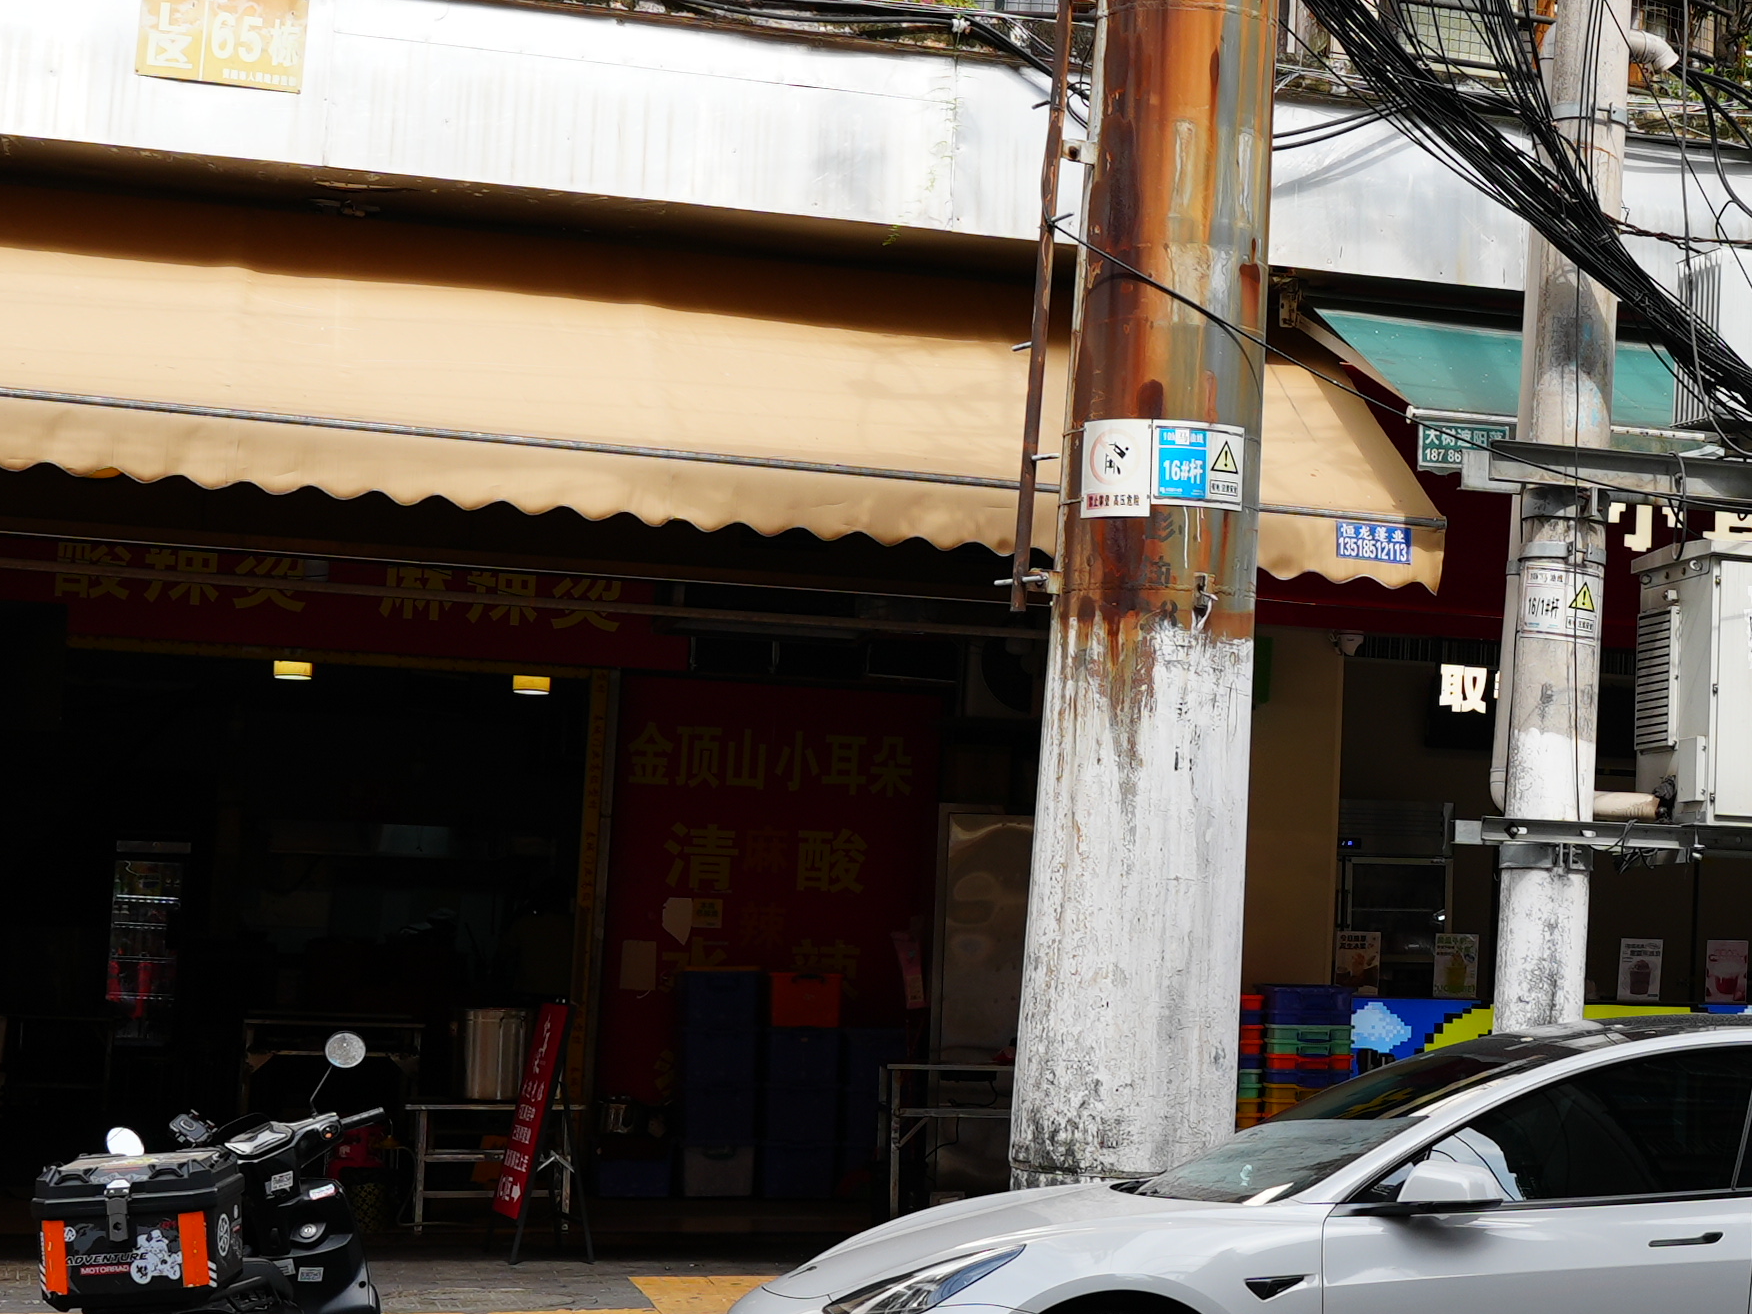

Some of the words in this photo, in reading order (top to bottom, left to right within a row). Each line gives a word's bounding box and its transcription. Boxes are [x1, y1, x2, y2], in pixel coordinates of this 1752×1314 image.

[1425, 448, 1444, 462] 187
[1163, 459, 1204, 485] 16#杆
[1338, 536, 1408, 562] 13518512113
[627, 720, 916, 798] 金顶山小耳朵
[65, 1251, 149, 1267] ADVENTURE
[80, 1263, 130, 1275] MOTORRAD
